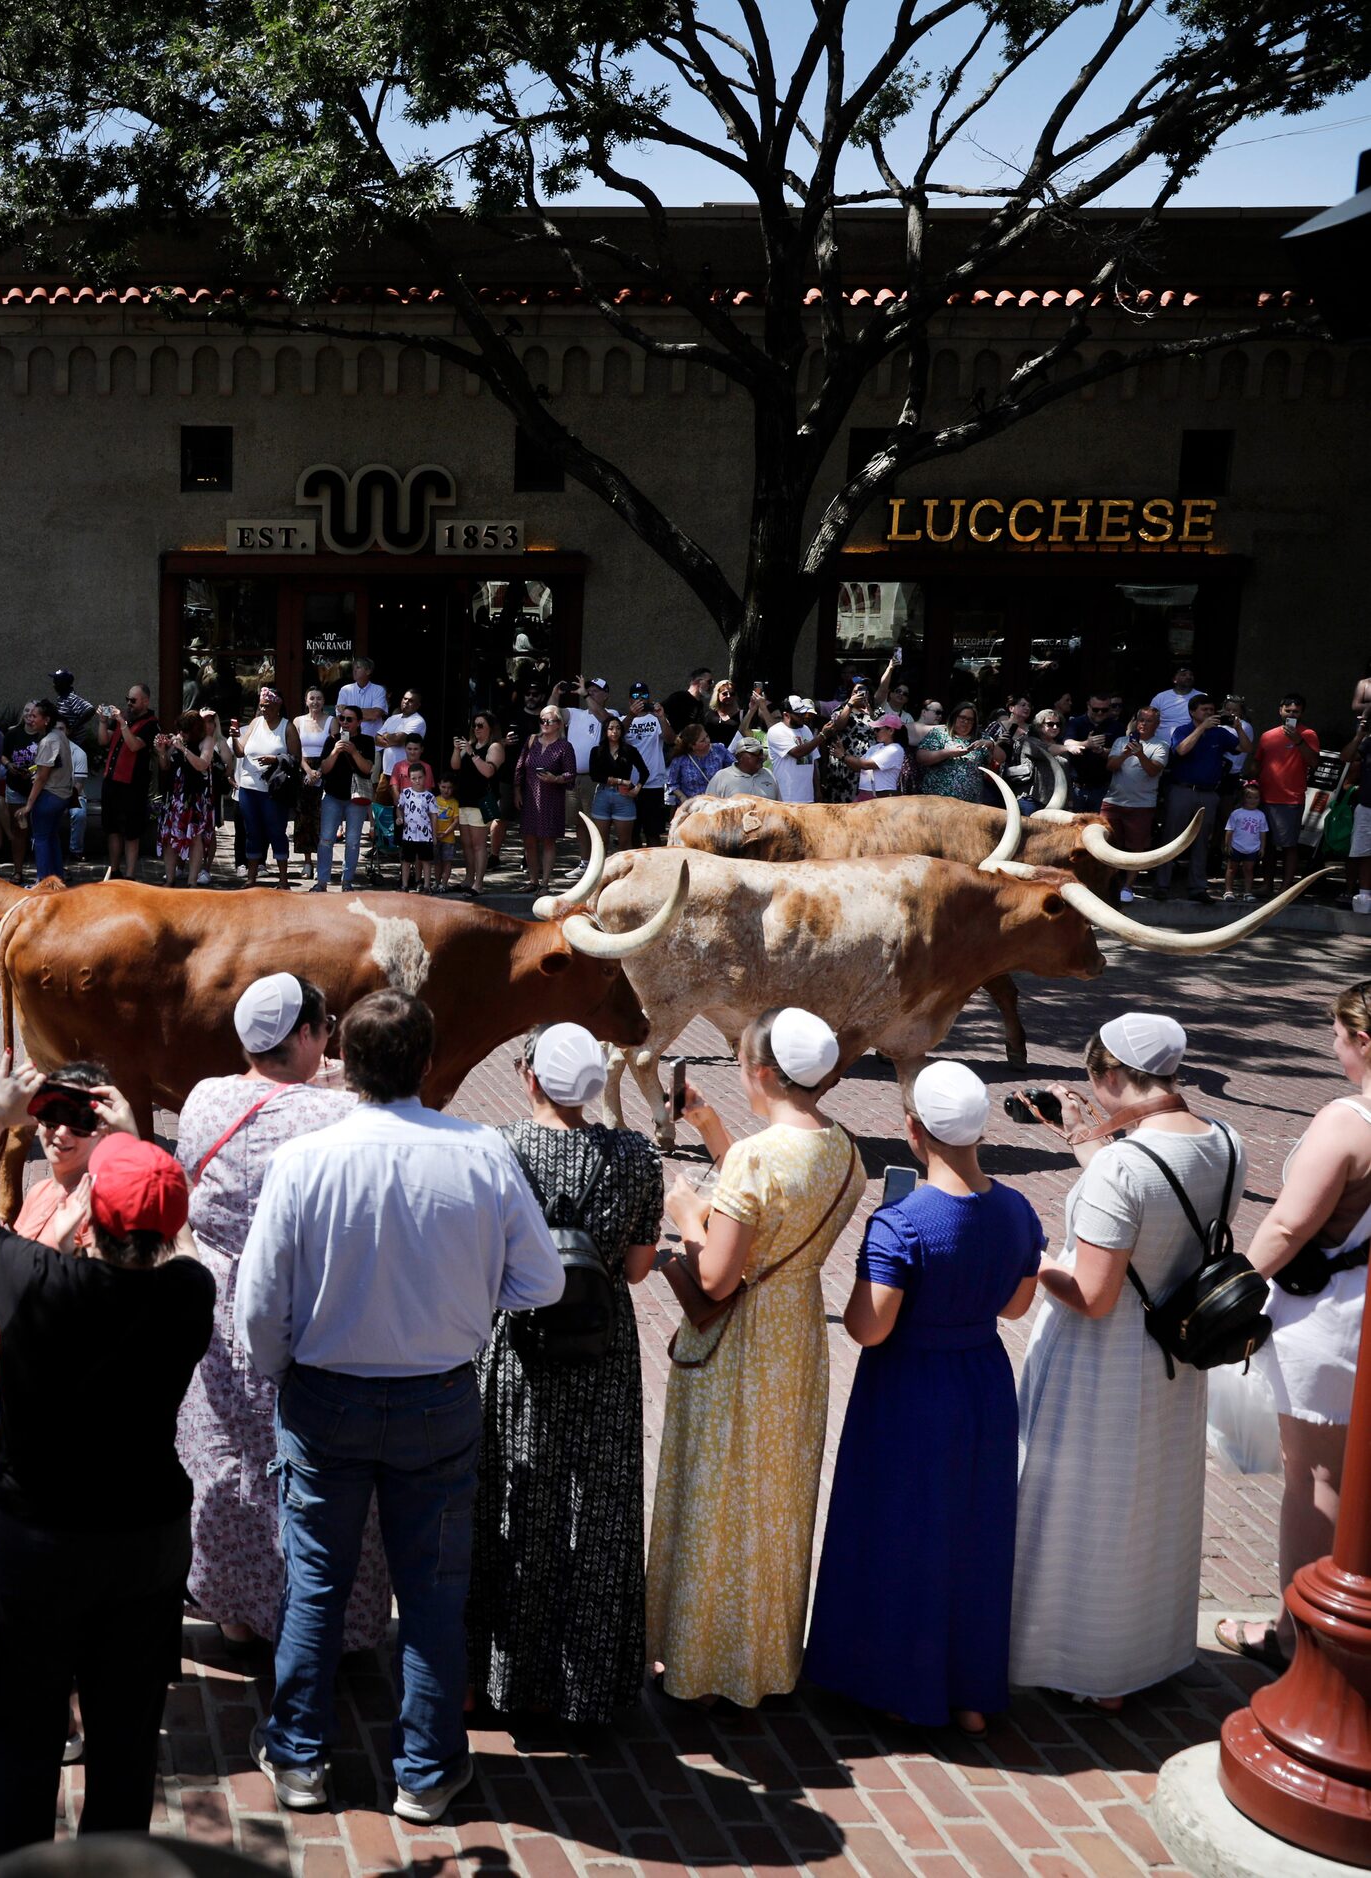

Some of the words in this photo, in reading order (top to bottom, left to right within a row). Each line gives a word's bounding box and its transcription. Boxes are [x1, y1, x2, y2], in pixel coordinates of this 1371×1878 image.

[886, 498, 1218, 543] LUCCHESE
[236, 526, 308, 549] EST.
[444, 524, 519, 549] 1853
[306, 639, 326, 650] KING
[326, 639, 352, 651] RANCH
[40, 965, 92, 992] 212
